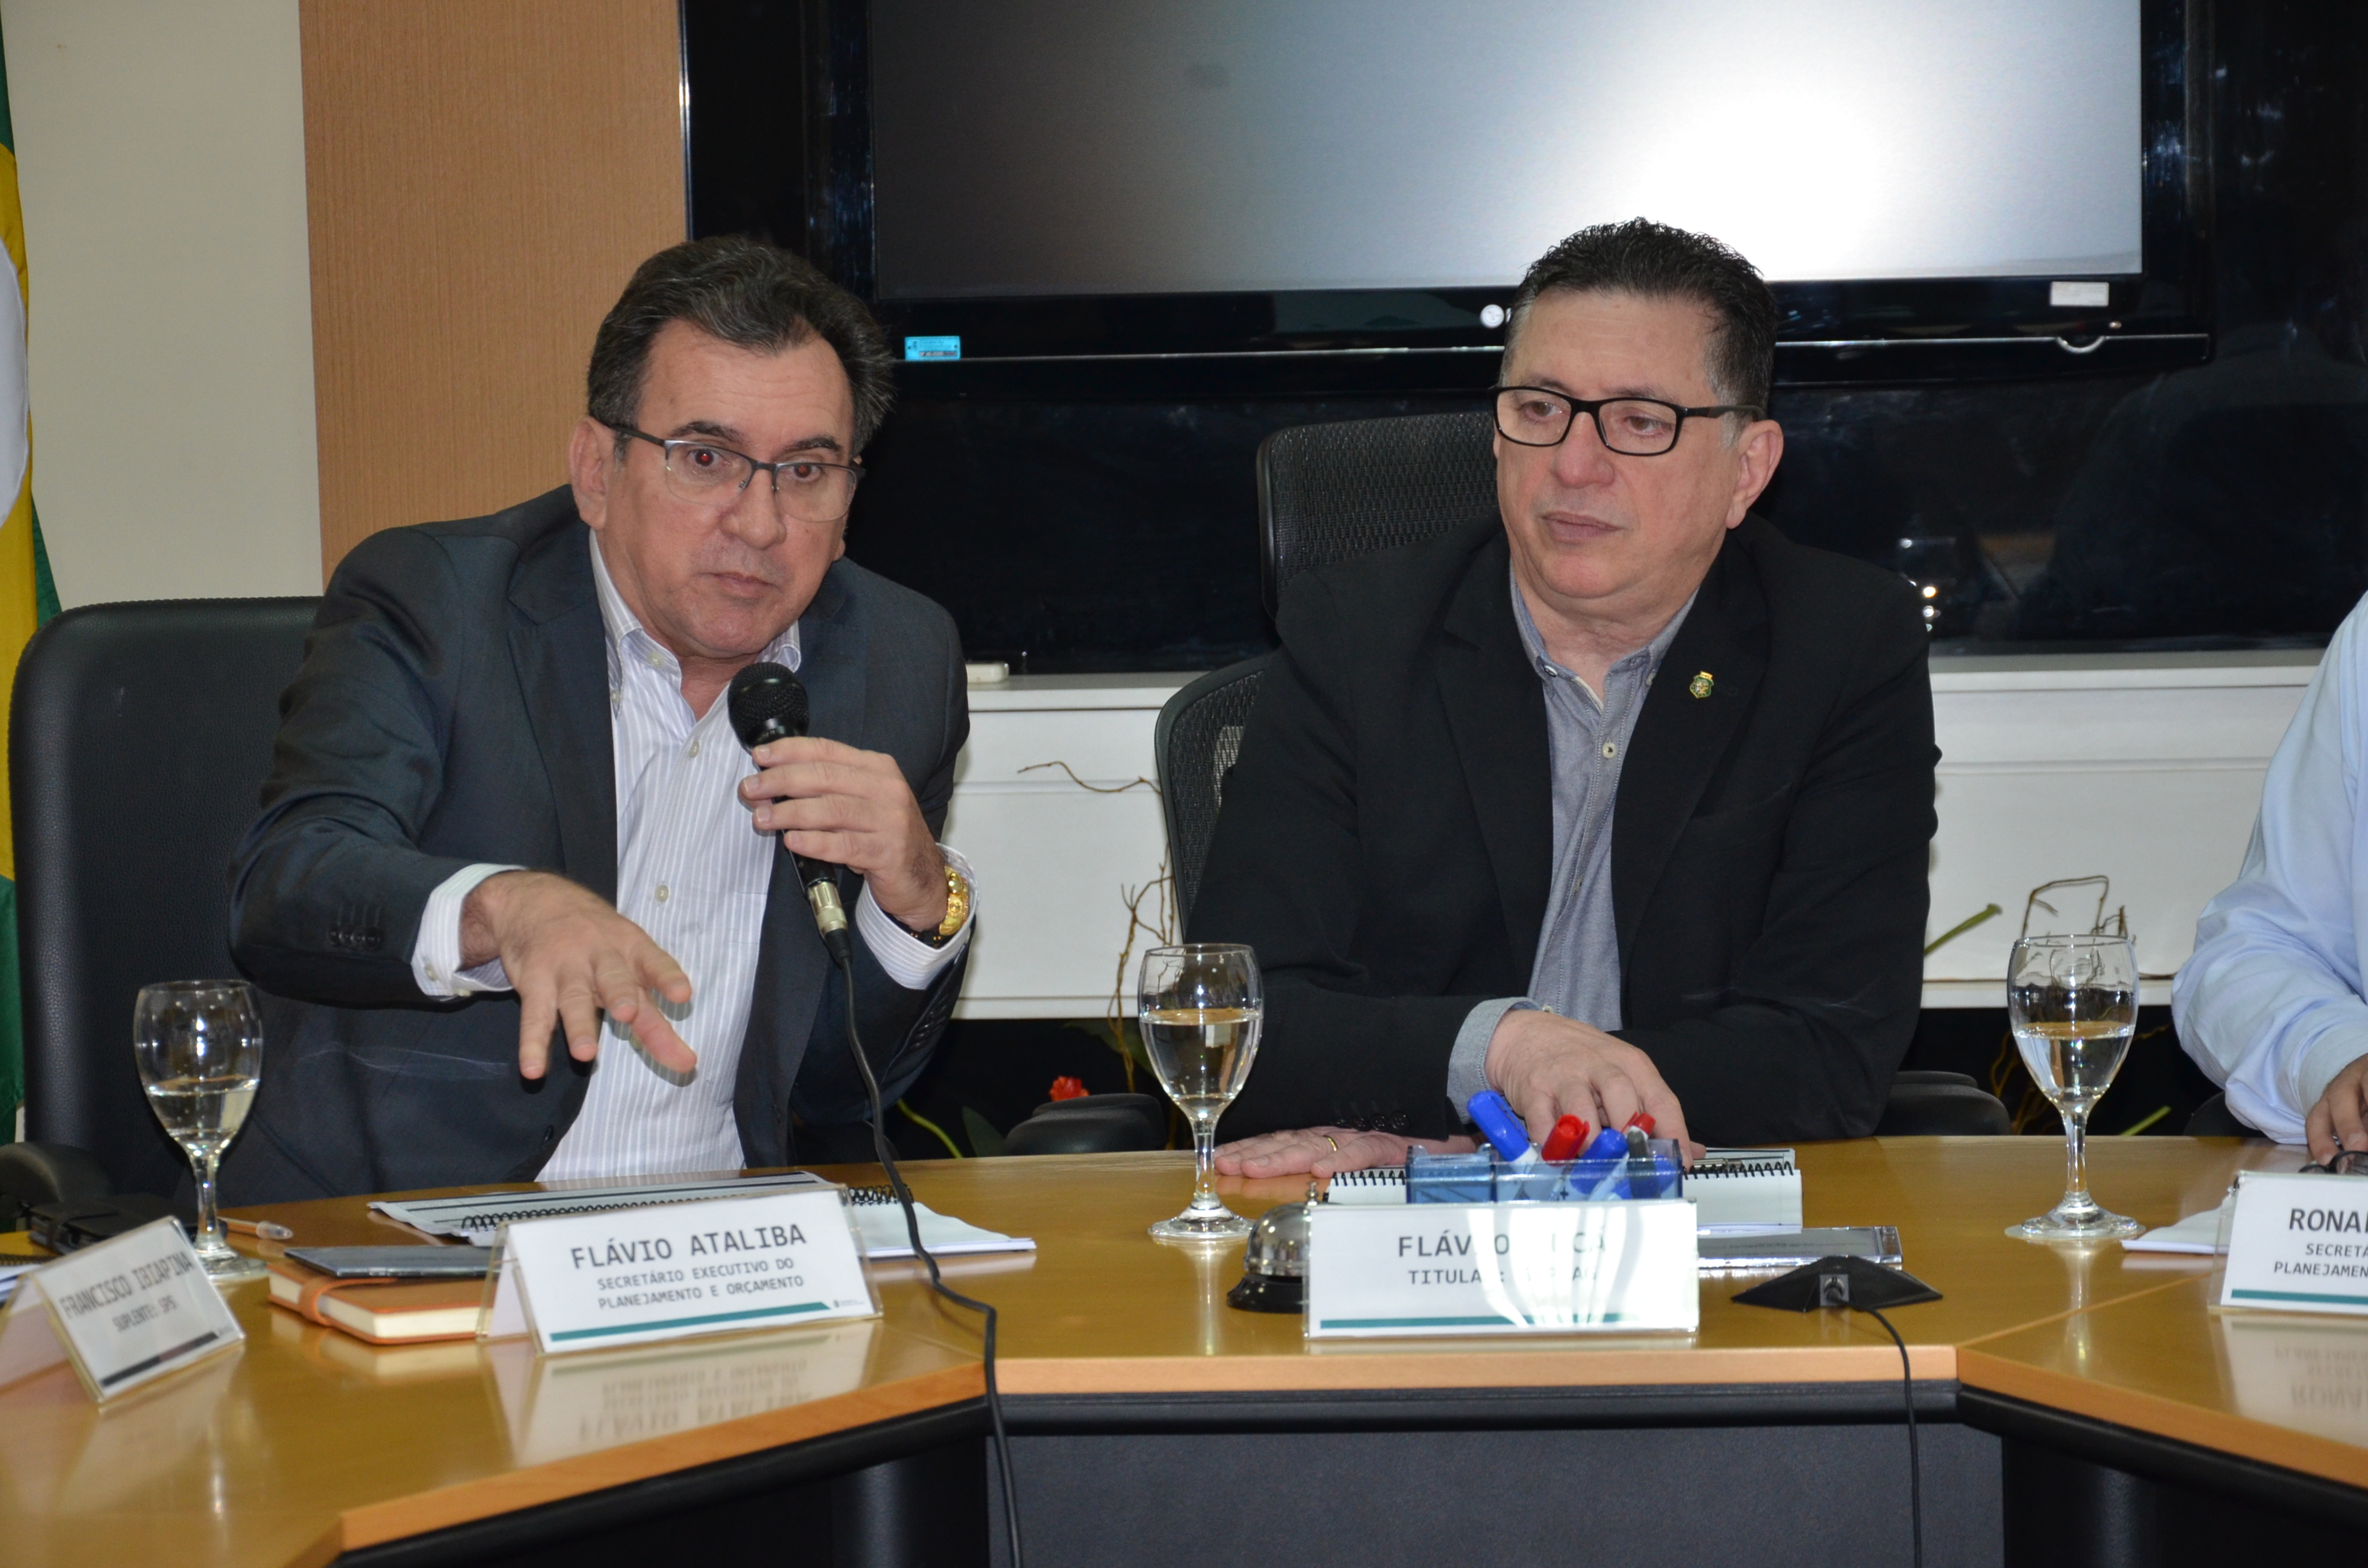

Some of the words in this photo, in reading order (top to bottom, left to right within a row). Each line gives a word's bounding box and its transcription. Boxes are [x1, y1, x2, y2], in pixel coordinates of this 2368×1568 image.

[2289, 1208, 2368, 1234] RONA
[570, 1237, 673, 1270] FLÁVIO
[691, 1223, 807, 1257] ATALIBA
[1399, 1229, 1509, 1257] FLÁVO
[59, 1275, 133, 1320] FRANCISCO
[131, 1252, 195, 1290] IBIAPINA
[596, 1270, 685, 1291] SECRETÁRIO
[691, 1260, 769, 1280] EXECUTIVO
[775, 1257, 794, 1270] DO
[1409, 1268, 1504, 1285] TITULA:
[597, 1287, 702, 1309] PLANEJAMENTO
[709, 1284, 719, 1297] E
[726, 1275, 805, 1295] ORÇAMENTO
[111, 1303, 158, 1332] SUPLENTE:
